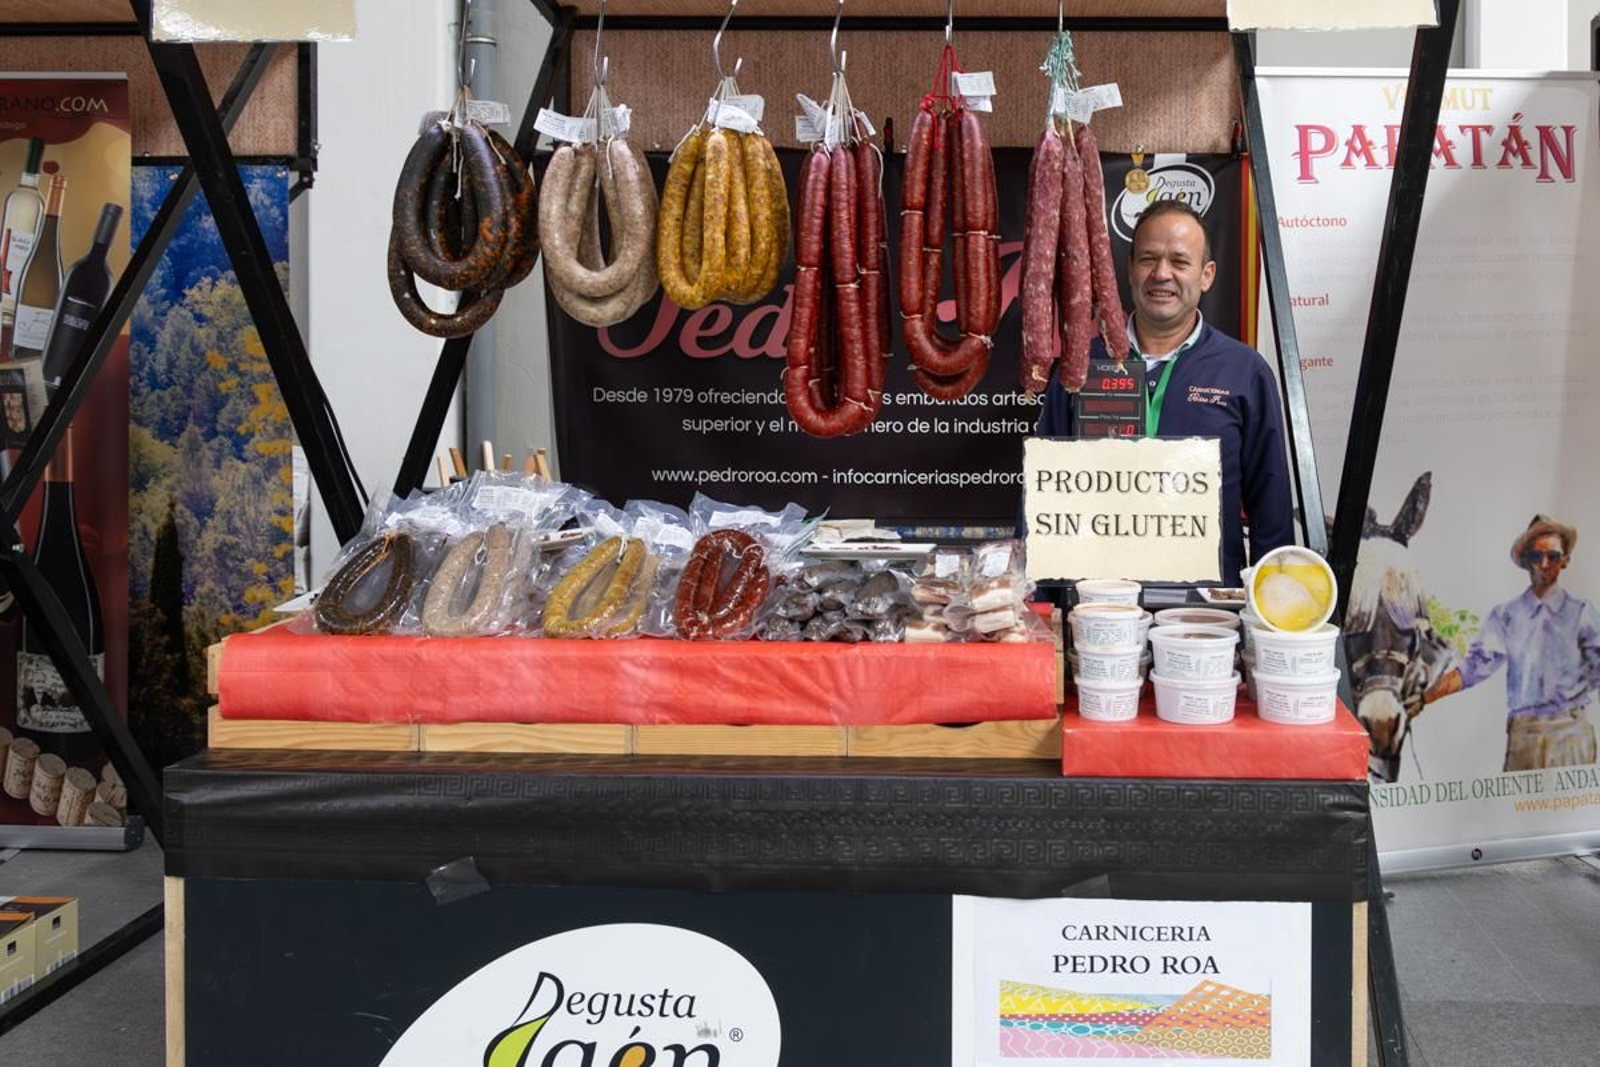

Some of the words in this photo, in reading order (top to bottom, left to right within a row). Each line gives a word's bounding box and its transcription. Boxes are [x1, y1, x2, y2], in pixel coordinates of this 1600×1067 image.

[1381, 82, 1493, 111] VMUT
[1277, 215, 1347, 229] Autóctono
[1289, 293, 1329, 307] atural
[1300, 356, 1334, 371] gante
[593, 387, 648, 403] Desde
[653, 388, 694, 403] 1979
[682, 417, 752, 434] superior
[755, 420, 766, 436] y
[768, 417, 784, 432] el
[907, 417, 931, 433] de
[933, 417, 950, 433] la
[953, 417, 1030, 433] industria
[651, 468, 818, 485] www.pedroroa.com
[1036, 470, 1209, 494] PRODUCTOS
[1036, 513, 1080, 536] SIN
[1091, 514, 1207, 537] GLUTEN
[1435, 781, 1469, 803] DEL
[1471, 773, 1544, 799] ORIENTE
[1061, 924, 1212, 942] CARNICERIA
[1052, 955, 1151, 975] PEDRO
[1161, 955, 1221, 976] ROA
[511, 971, 697, 1025] Degusta
